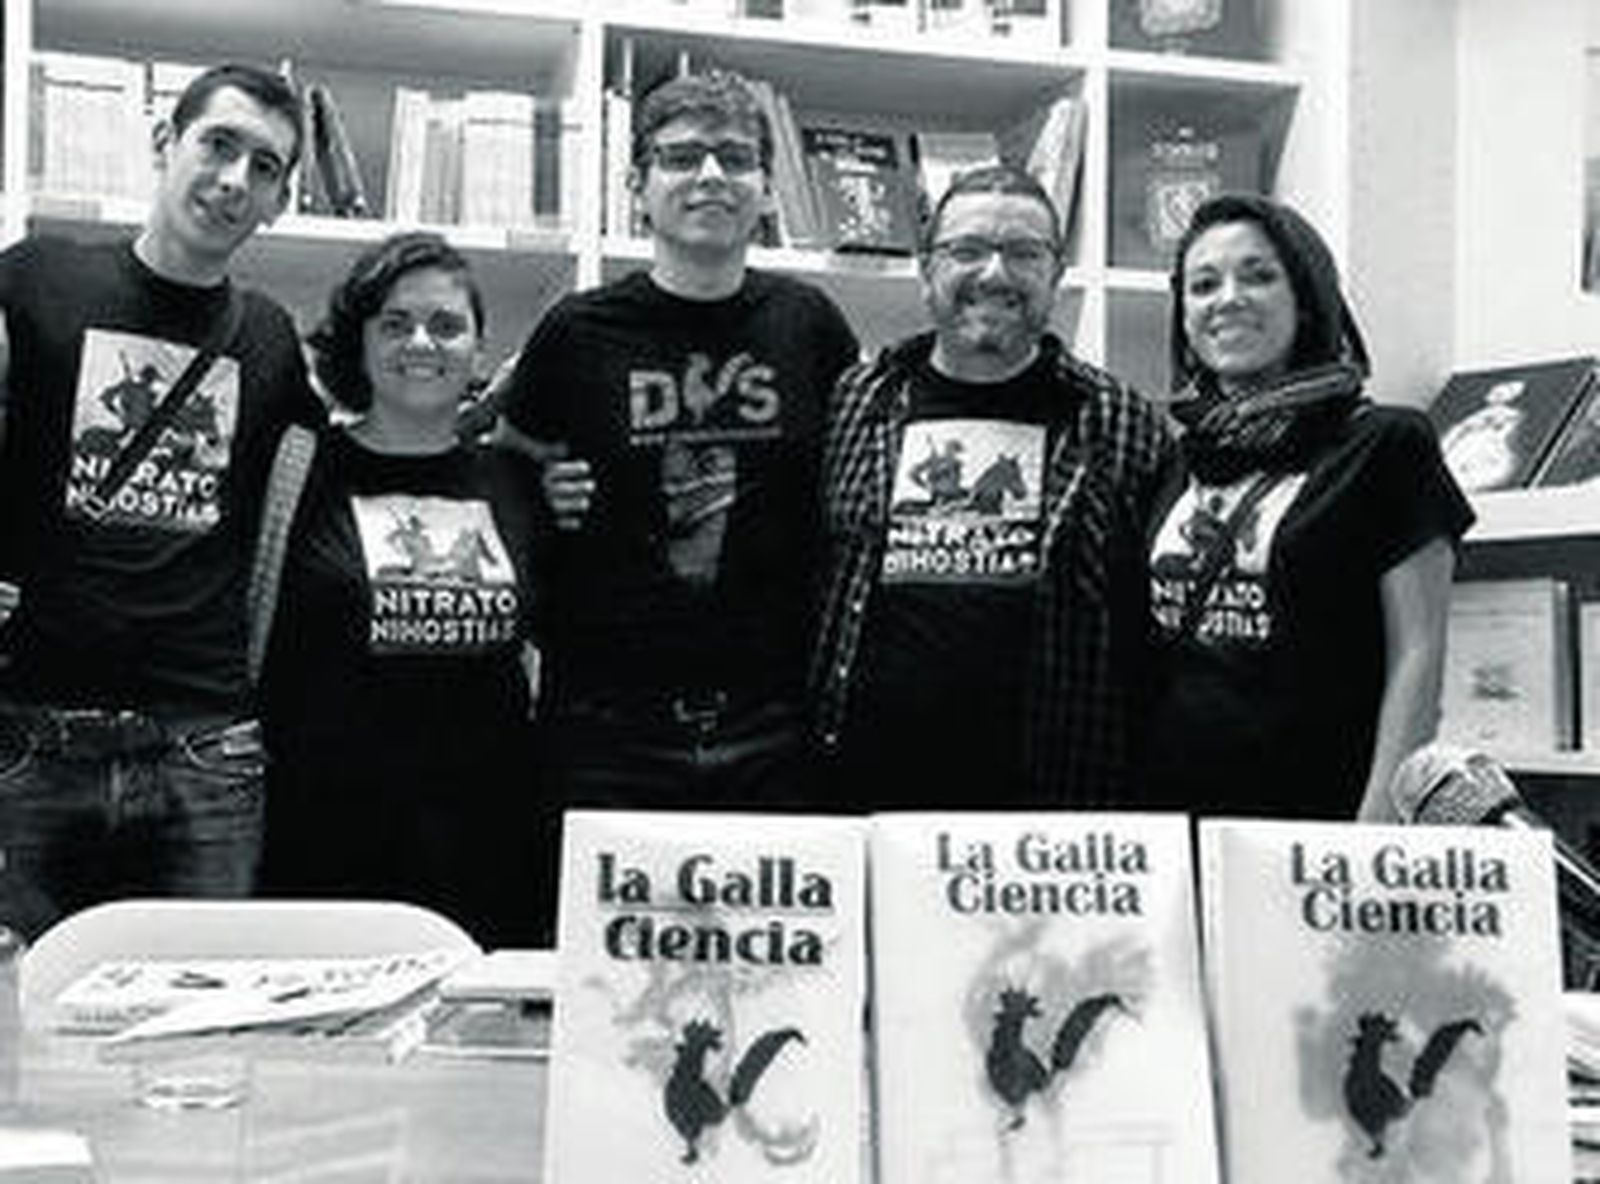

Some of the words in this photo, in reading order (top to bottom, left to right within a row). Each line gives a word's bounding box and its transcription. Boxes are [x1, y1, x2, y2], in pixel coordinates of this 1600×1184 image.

[71, 454, 217, 498] NIRATO
[374, 588, 517, 615] NITRATO
[937, 832, 994, 872] La
[1016, 832, 1148, 873] Galla
[1292, 842, 1350, 885] La
[1372, 845, 1509, 892] Galla
[677, 854, 832, 908] Galla
[947, 871, 1143, 916] Ciencia
[1303, 886, 1502, 937] Ciencia
[605, 915, 823, 965] Ciencia
